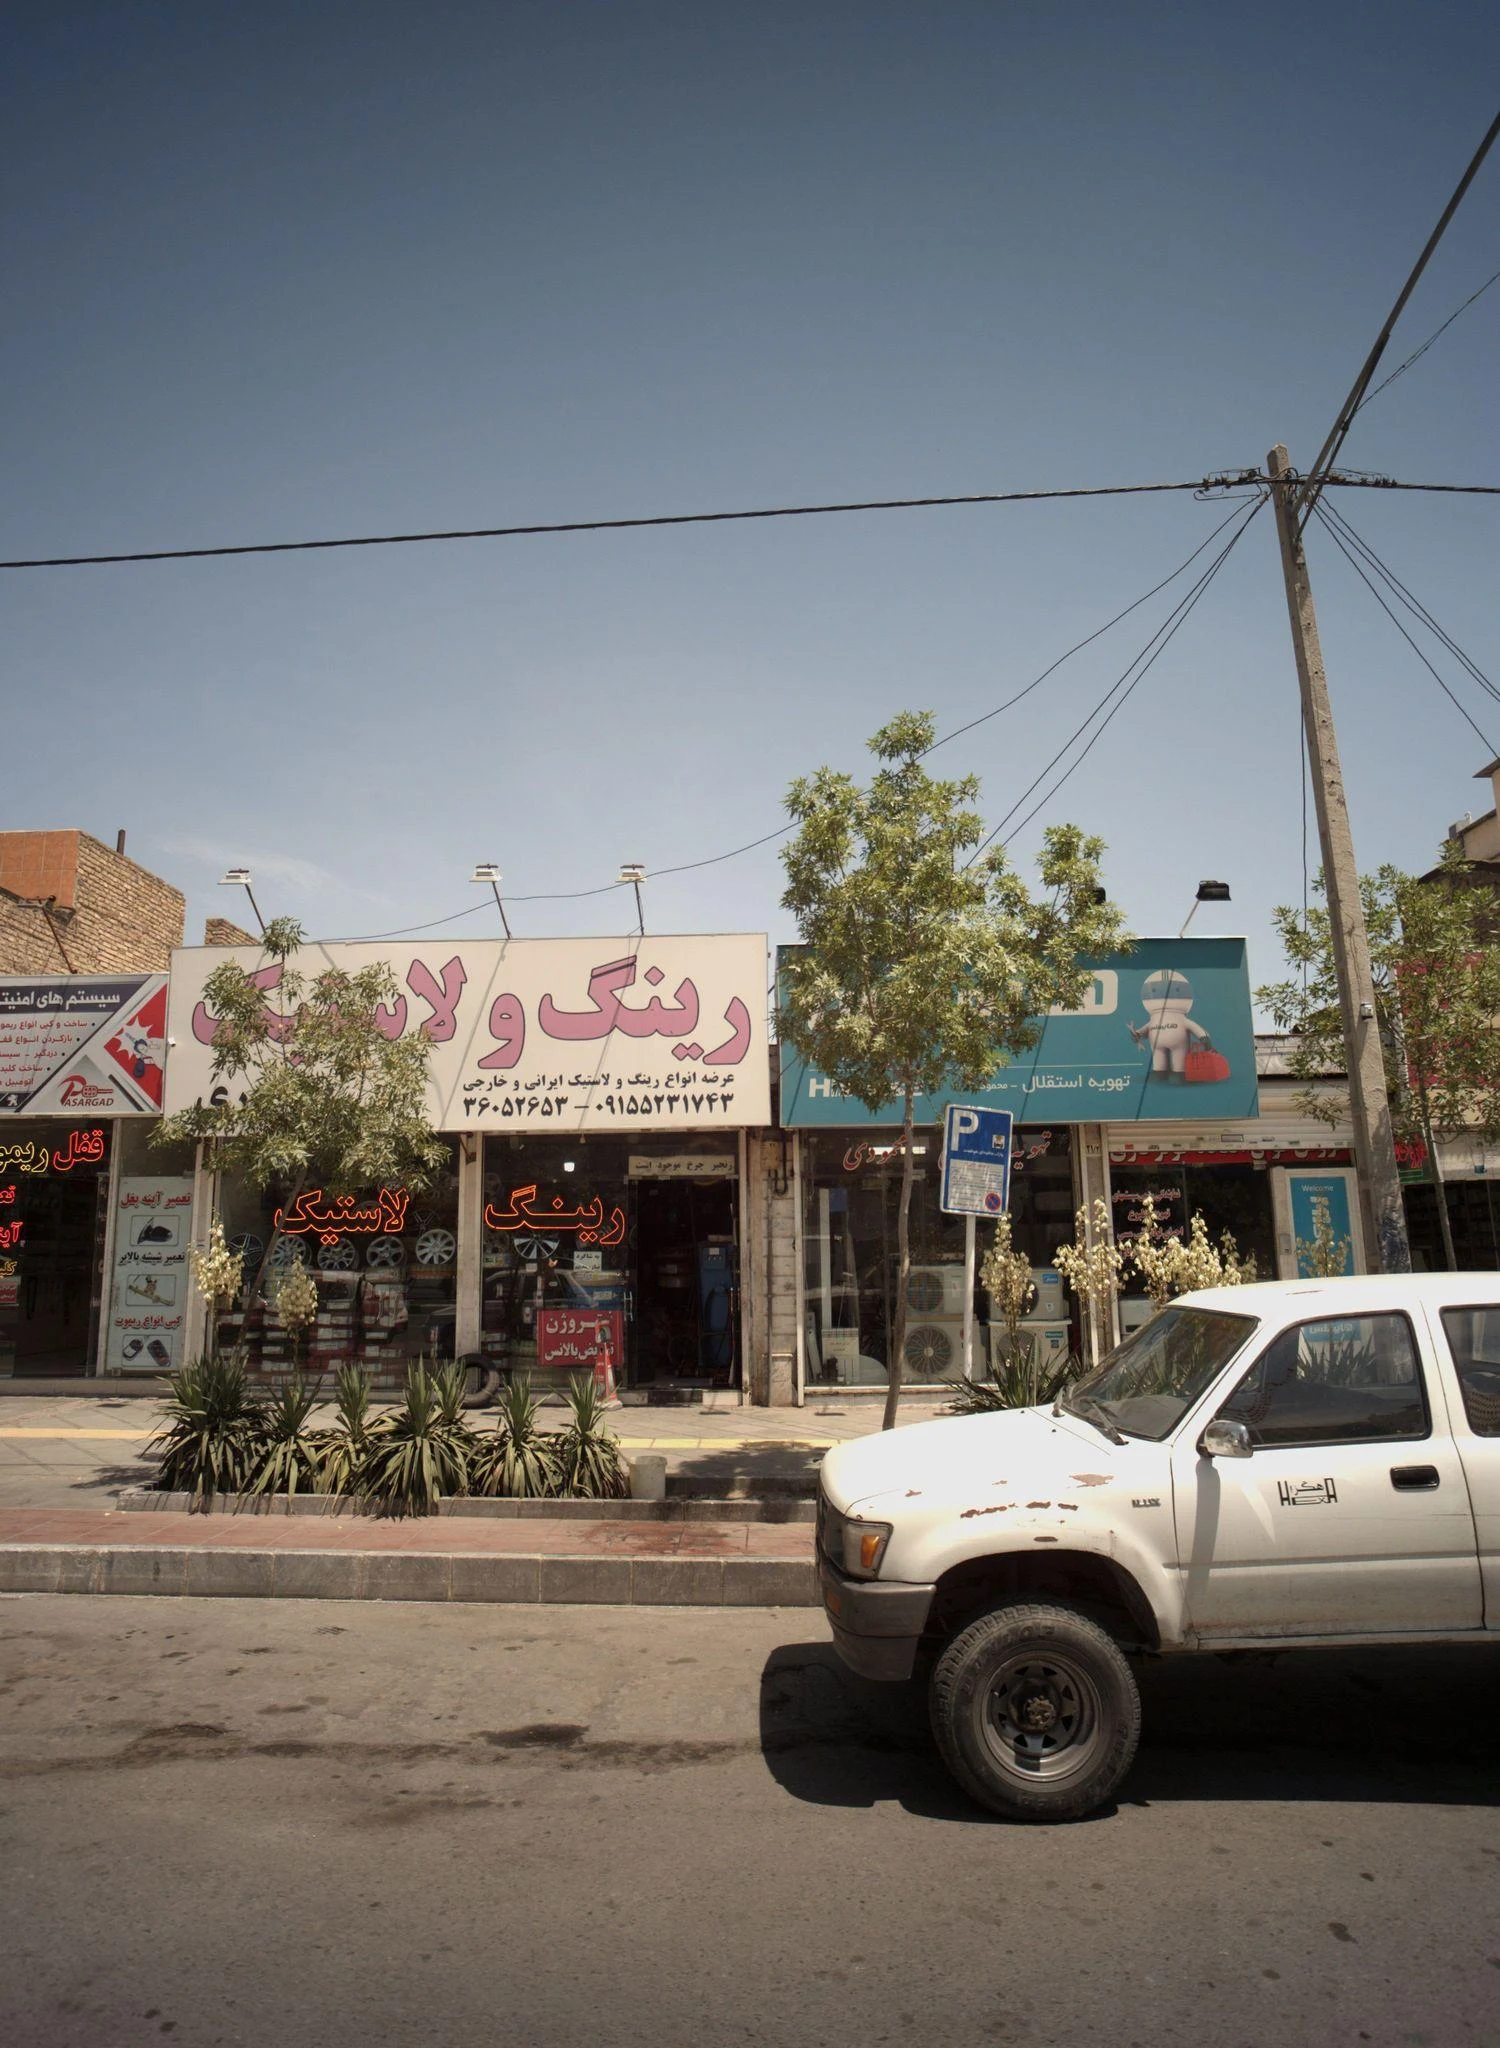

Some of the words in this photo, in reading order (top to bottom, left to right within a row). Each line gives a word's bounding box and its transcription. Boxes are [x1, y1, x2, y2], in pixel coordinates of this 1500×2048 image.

[0, 991, 34, 1010] امنیت
[36, 991, 63, 1008] های
[65, 991, 120, 1010] سیستم
[538, 955, 751, 1065] رینگ
[19, 1020, 37, 1030] انواع
[64, 1020, 87, 1028] ساخت
[477, 993, 525, 1069] و
[15, 1035, 39, 1045] انواع
[18, 1065, 43, 1073] ساخت
[463, 1075, 508, 1092] خارجی
[513, 1079, 520, 1090] و
[524, 1075, 563, 1091] ایرانی
[568, 1073, 611, 1090] لاستیک
[615, 1078, 623, 1089] و
[627, 1073, 659, 1089] رینگ
[664, 1072, 696, 1088] انواع
[701, 1073, 735, 1087] عرضه
[1022, 1074, 1082, 1093] استقلال
[1088, 1075, 1131, 1092] تهویه
[57, 1075, 114, 1106] PASARGAD
[463, 1096, 569, 1118] ۳۶۰۵۲۶۵۳
[595, 1093, 735, 1116] ۰۹۱۵۵۲۳۱۷۴۳
[951, 1109, 979, 1151] P
[0, 1141, 49, 1173] ریمو
[53, 1129, 104, 1171] قفل
[657, 1161, 681, 1172] موجود
[1301, 1184, 1334, 1192] Welcome
[119, 1192, 139, 1209] بغل
[142, 1191, 164, 1208] آینه
[164, 1192, 193, 1209] تعمیر
[274, 1187, 410, 1246] لاستیک
[485, 1184, 625, 1245] رینگ
[118, 1252, 139, 1266] بالابر
[142, 1252, 162, 1265] شیشه
[163, 1252, 186, 1266] تعمیر
[115, 1317, 141, 1330] ریموت
[142, 1315, 163, 1330] انواع
[162, 1315, 183, 1330] کپی
[544, 1342, 578, 1361] بالانس
